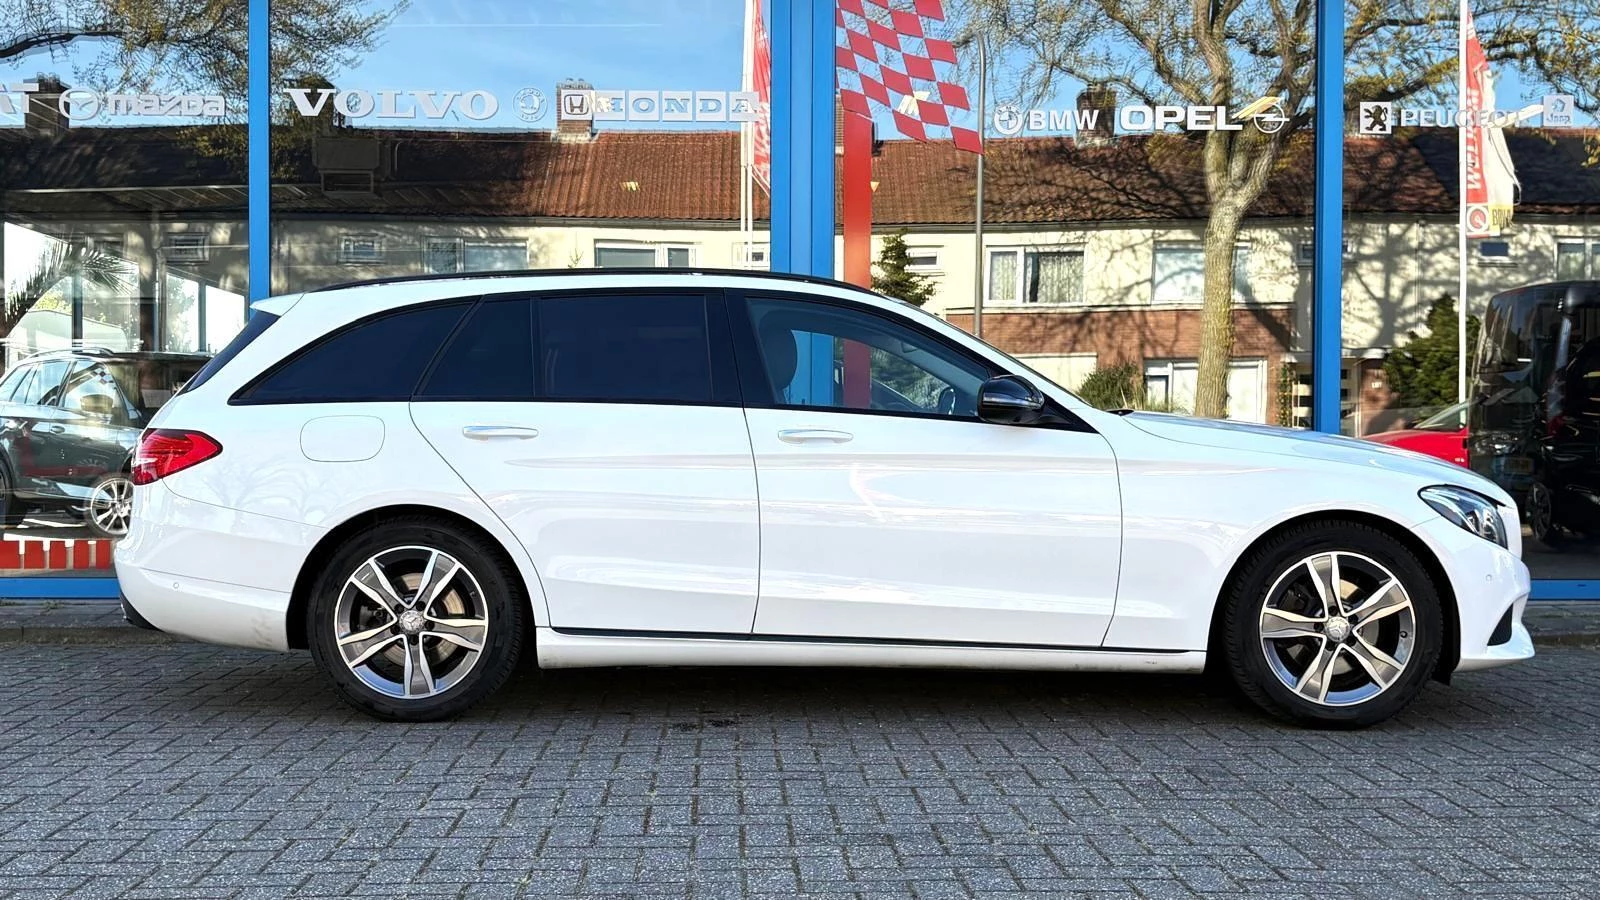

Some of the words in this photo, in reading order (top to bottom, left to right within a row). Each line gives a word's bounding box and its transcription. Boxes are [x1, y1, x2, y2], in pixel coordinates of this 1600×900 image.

[283, 88, 499, 119] VOLVO
[594, 95, 759, 115] HONDA
[1029, 109, 1099, 130] BMW
[1120, 105, 1243, 131] OPEL
[1400, 109, 1523, 127] PEUGEOT
